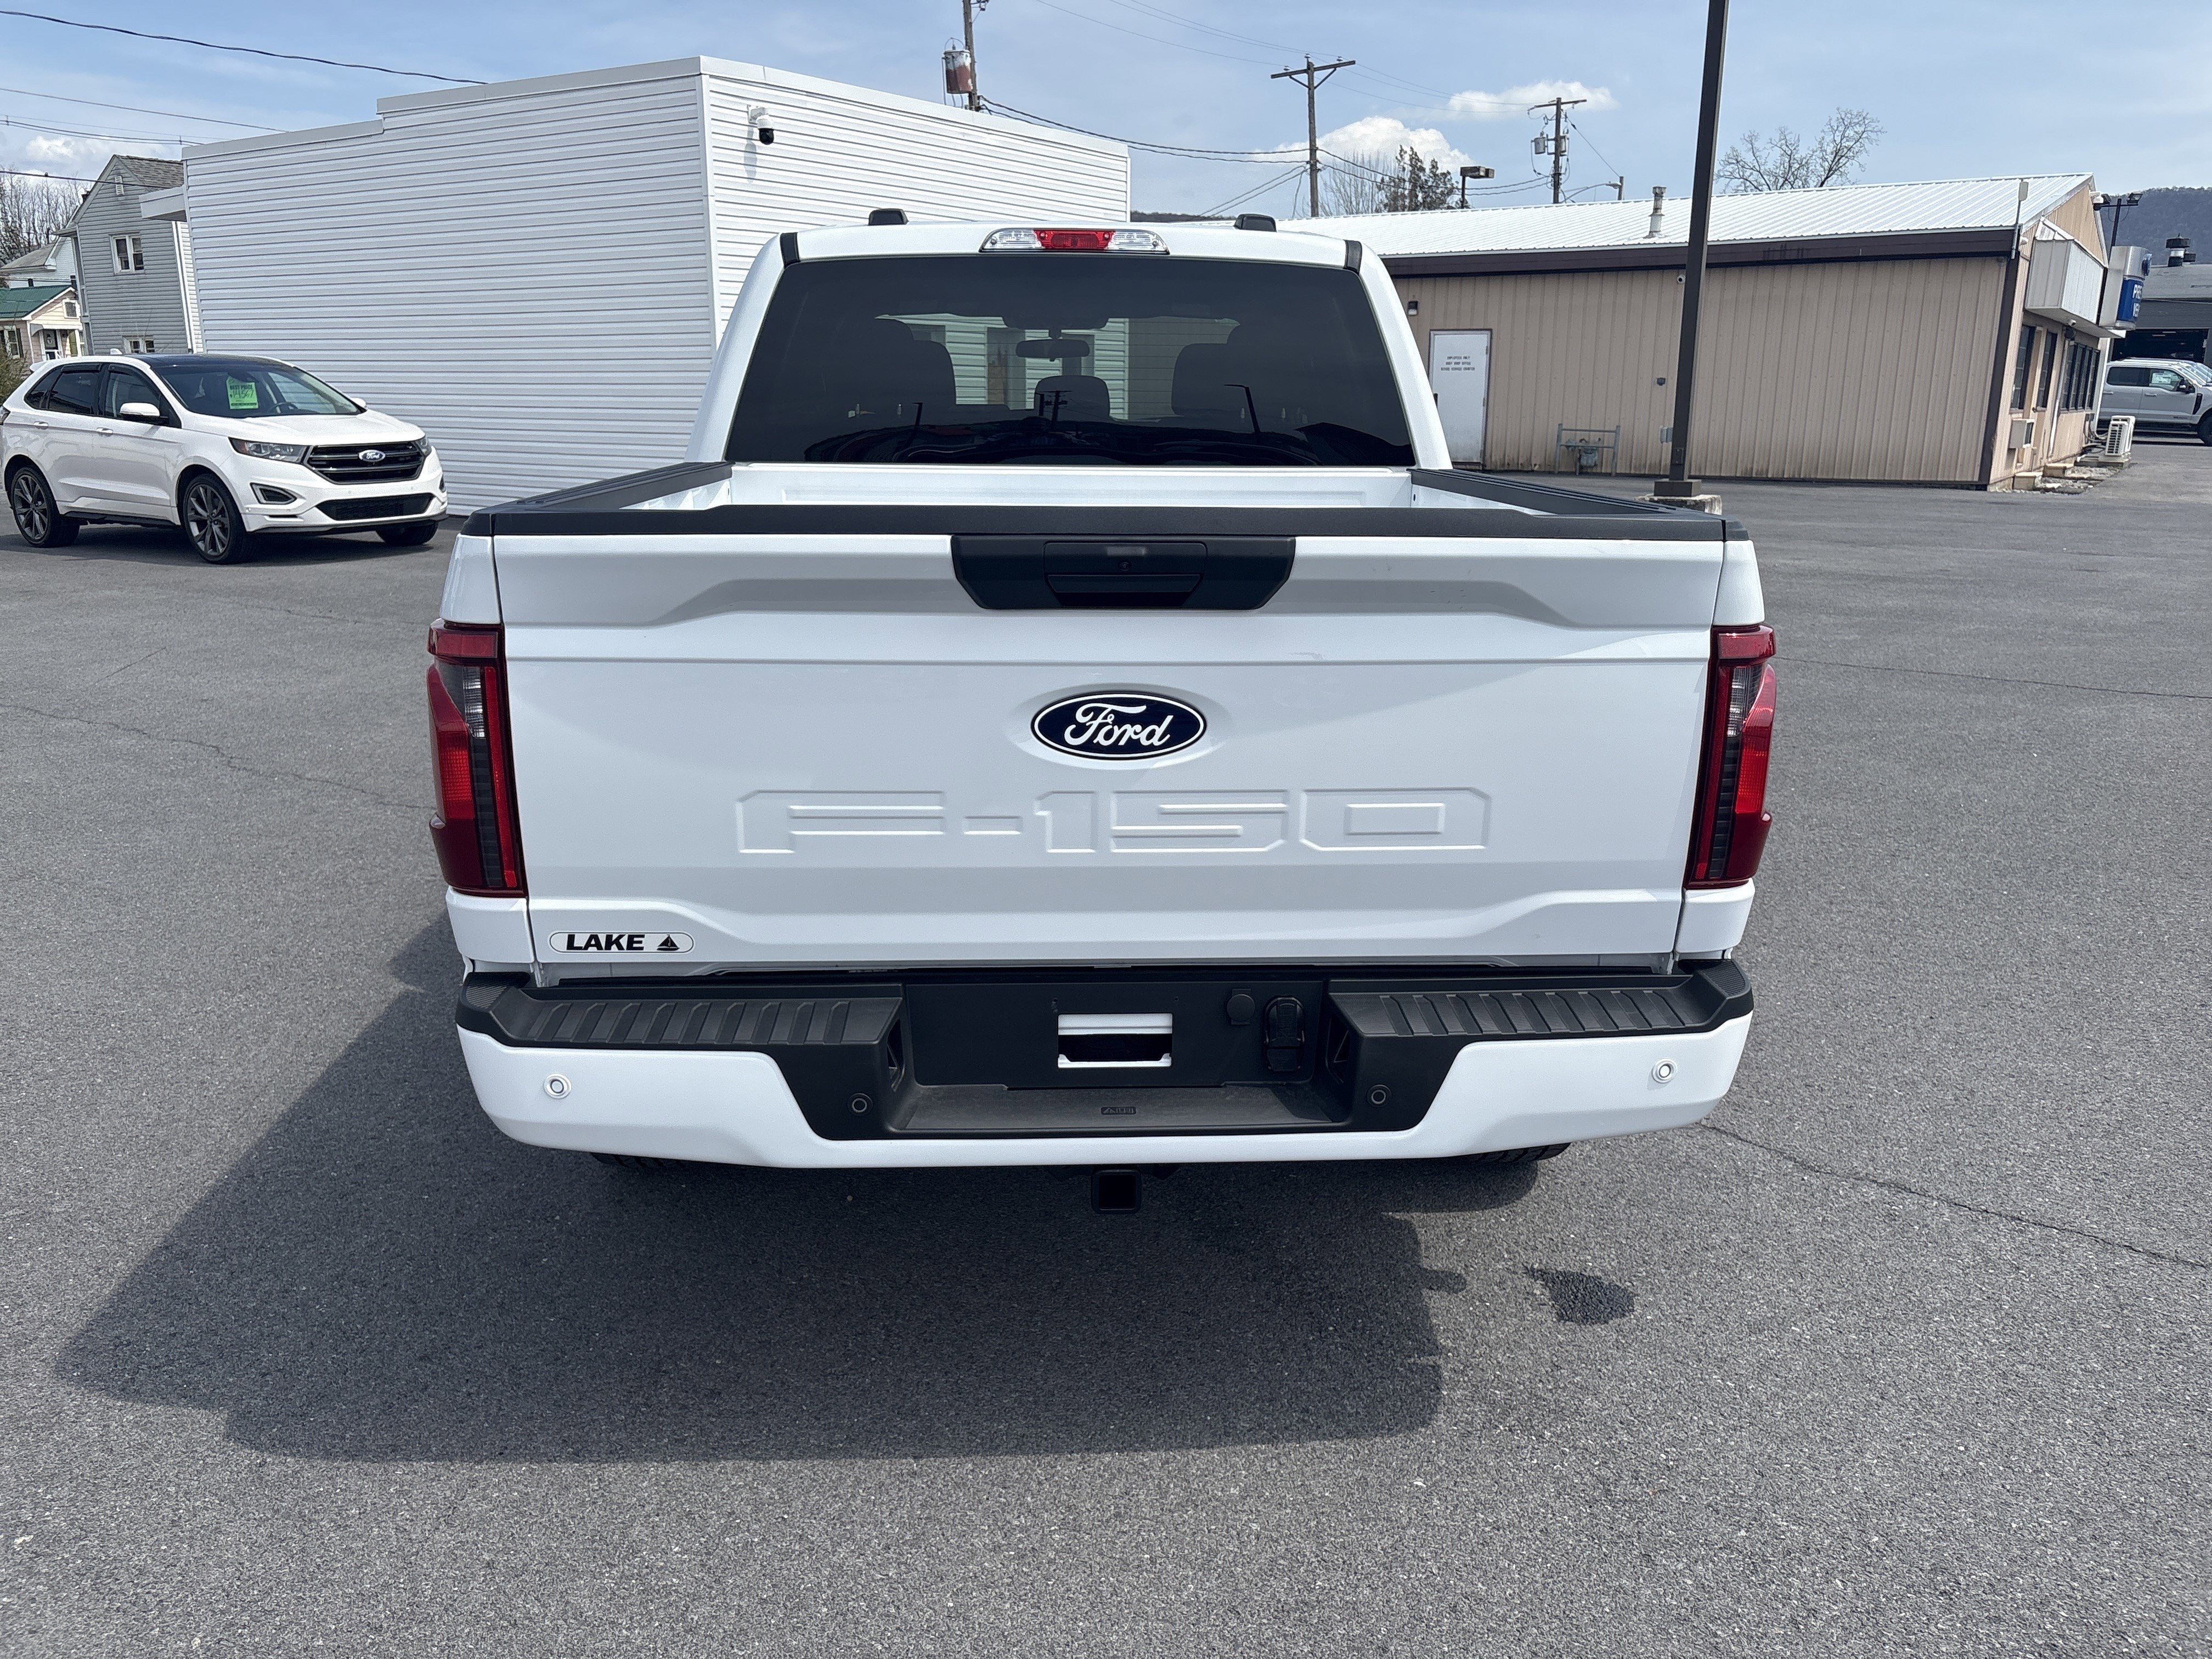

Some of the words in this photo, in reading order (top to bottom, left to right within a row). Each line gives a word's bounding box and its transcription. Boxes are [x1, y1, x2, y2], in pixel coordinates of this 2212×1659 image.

[1064, 702, 1174, 746] Ford
[736, 788, 1492, 854] F-150
[566, 934, 645, 951] LAKE
